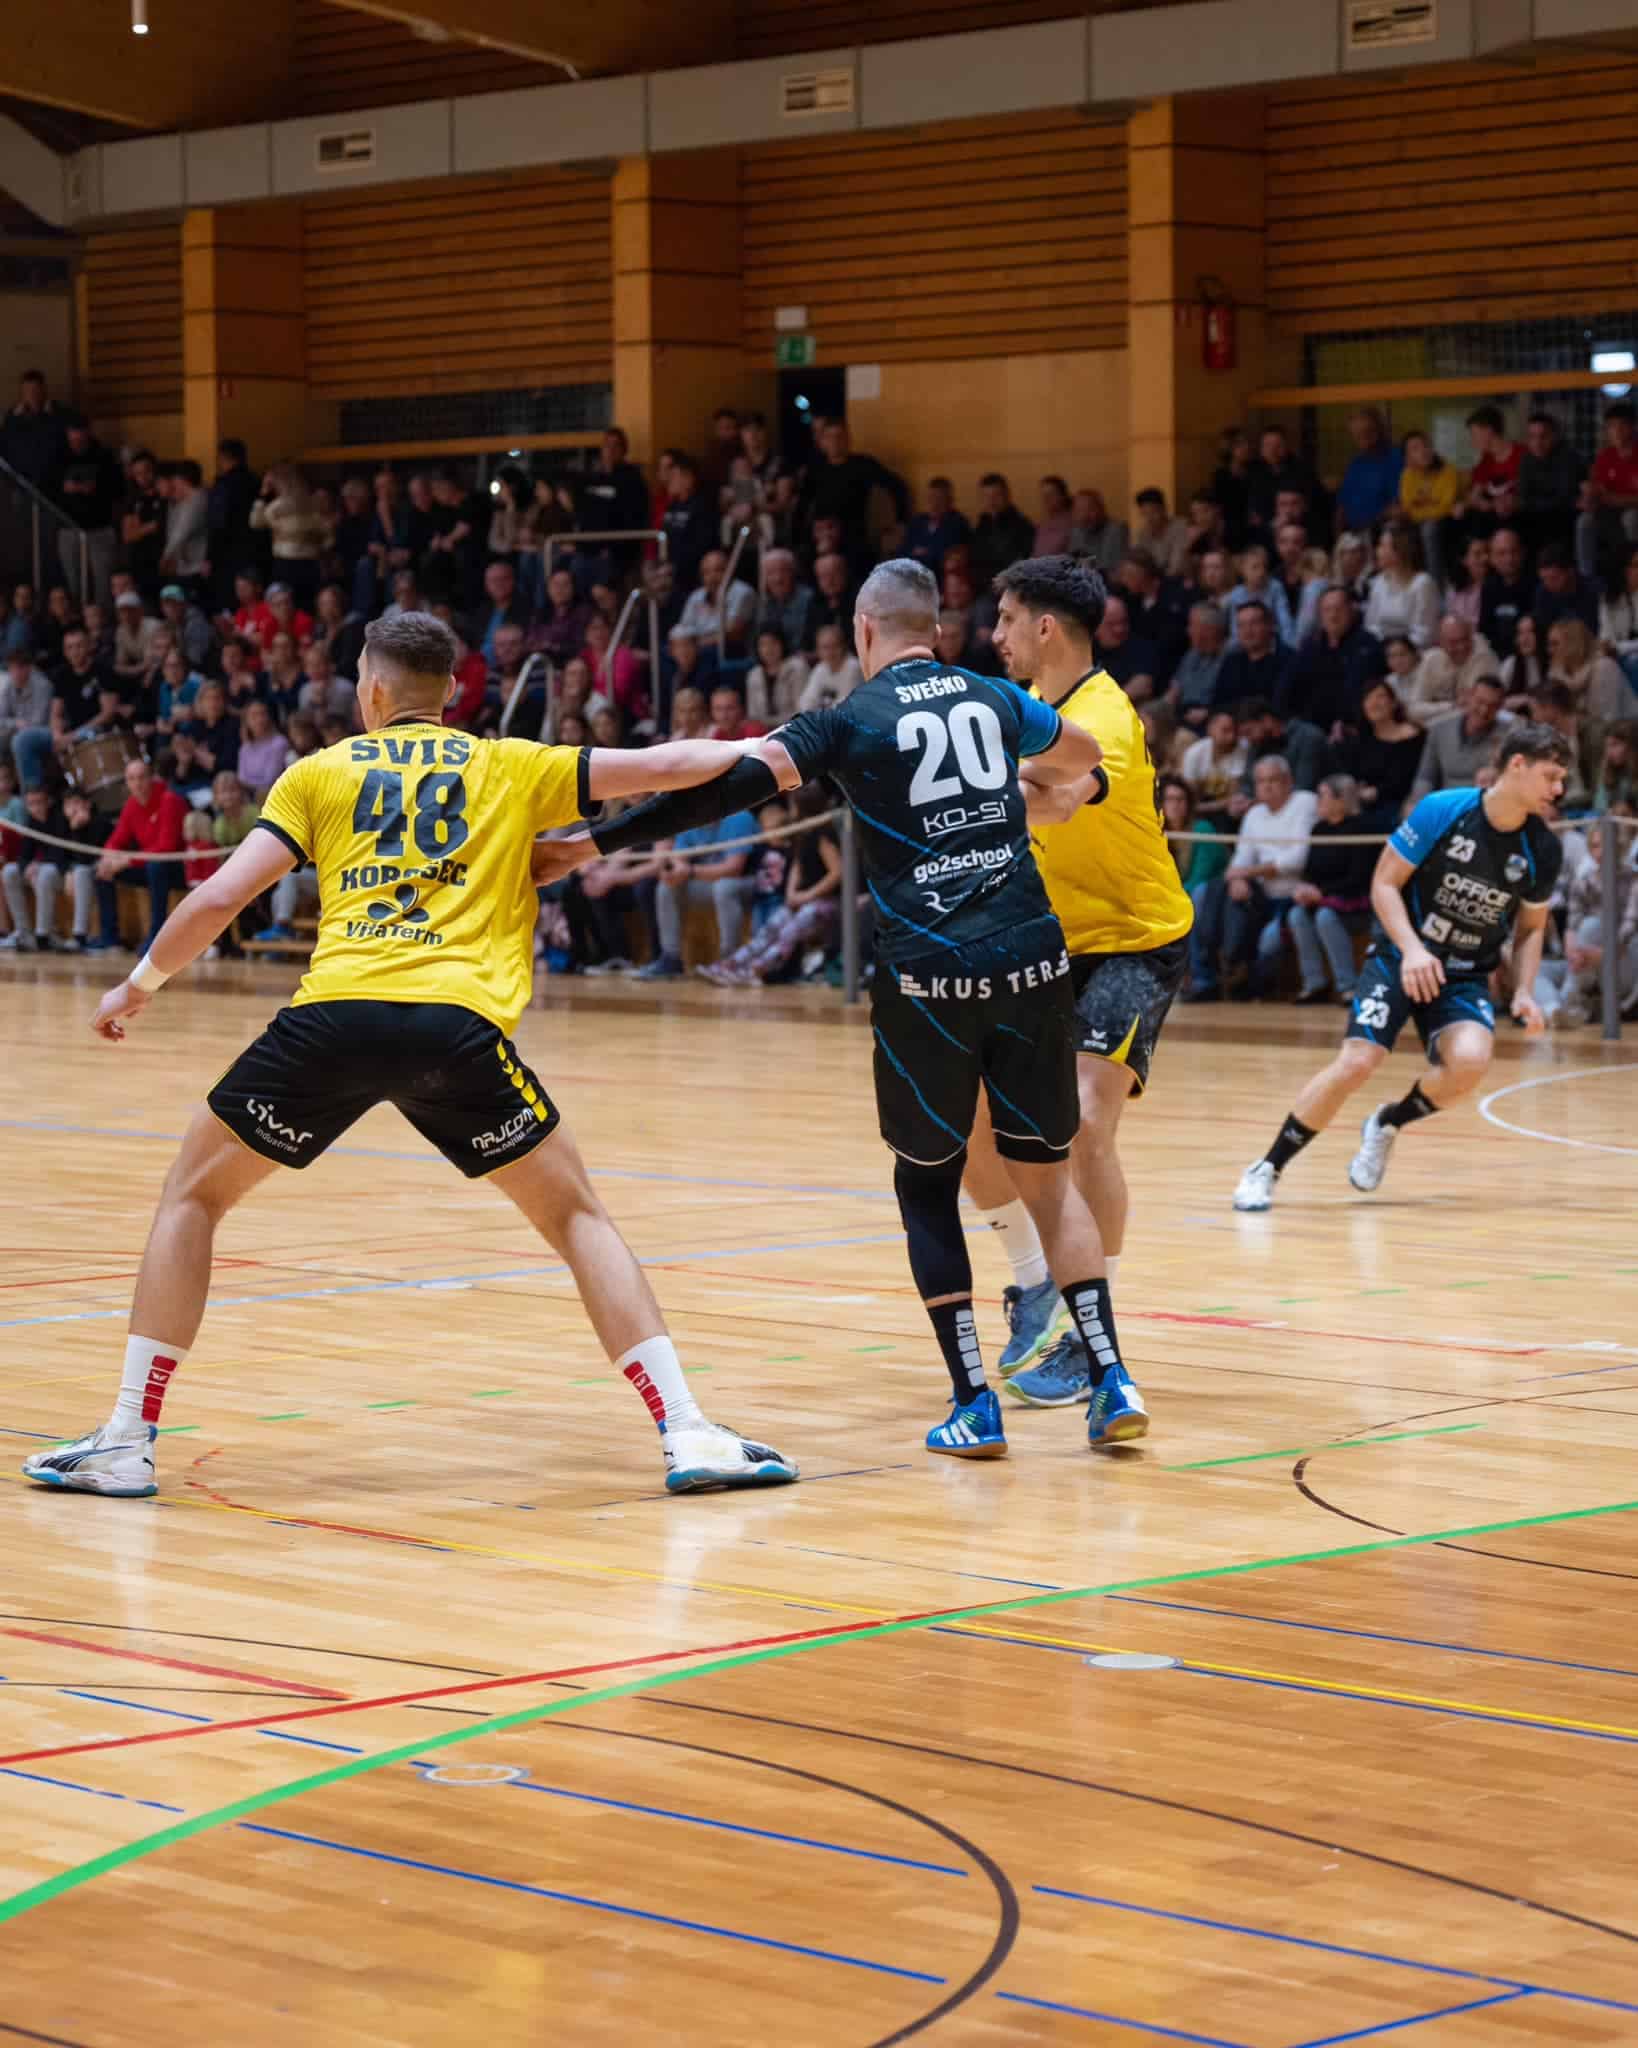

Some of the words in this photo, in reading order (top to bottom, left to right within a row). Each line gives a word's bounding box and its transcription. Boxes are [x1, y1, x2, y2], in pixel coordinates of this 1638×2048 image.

[895, 675, 968, 703] SVEČKO
[896, 701, 1008, 807] 20
[353, 768, 468, 858] 48
[914, 843, 1013, 884] go2school
[1447, 834, 1477, 863] 23
[1443, 872, 1512, 907] OFFICE
[1357, 998, 1391, 1029] 23
